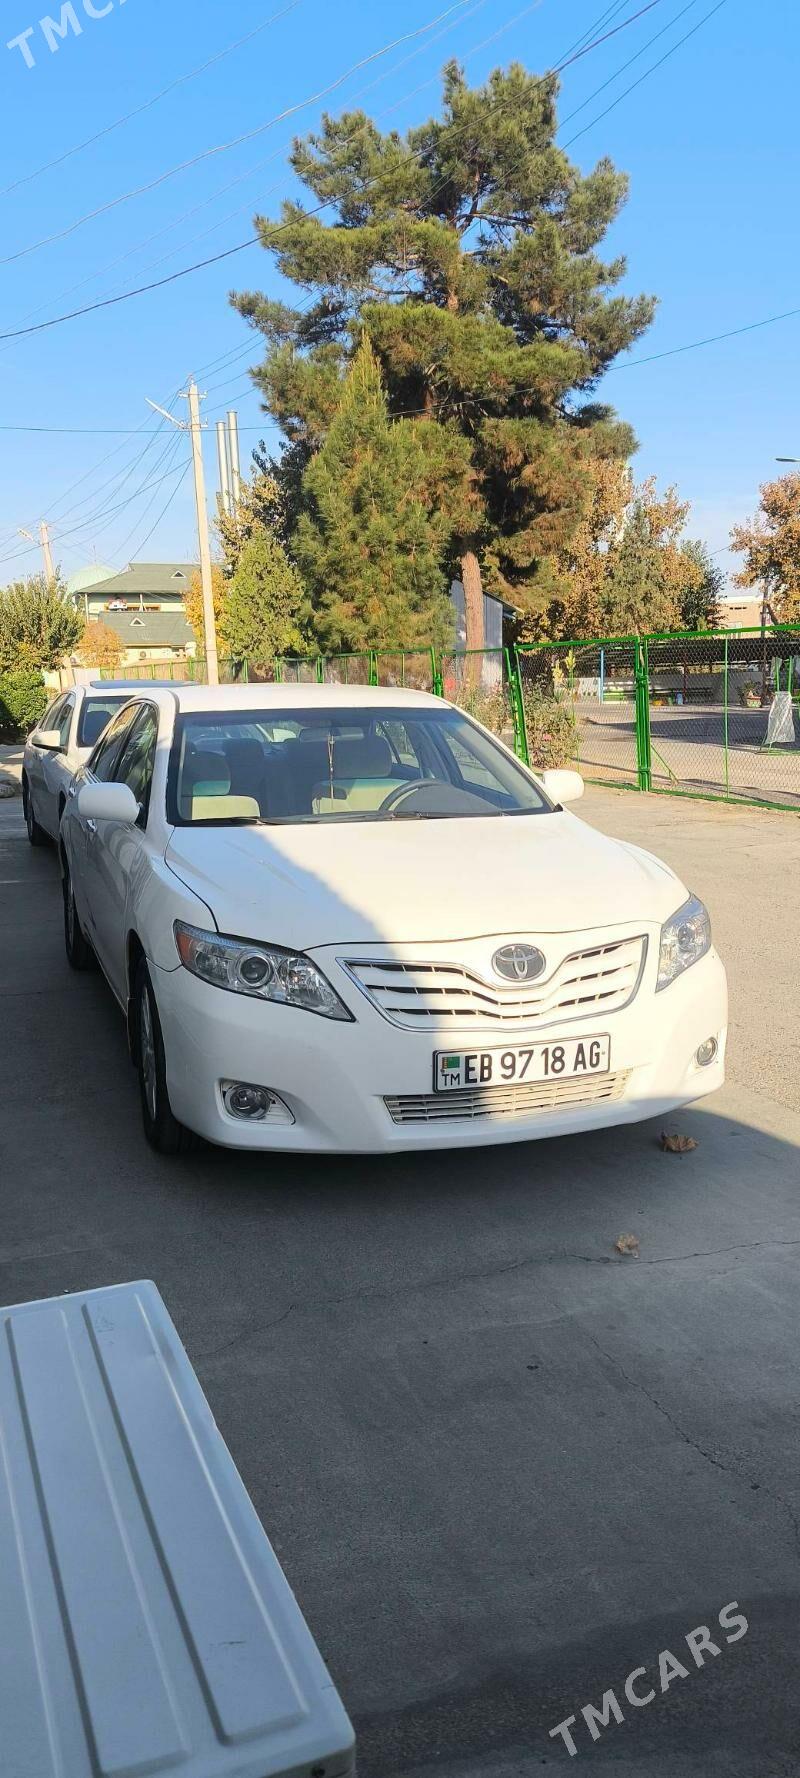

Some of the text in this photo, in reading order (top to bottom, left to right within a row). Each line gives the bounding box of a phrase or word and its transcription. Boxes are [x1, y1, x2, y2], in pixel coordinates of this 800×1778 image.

[464, 1040, 601, 1084] EB 97 18 AG
[441, 1073, 461, 1086] TM
